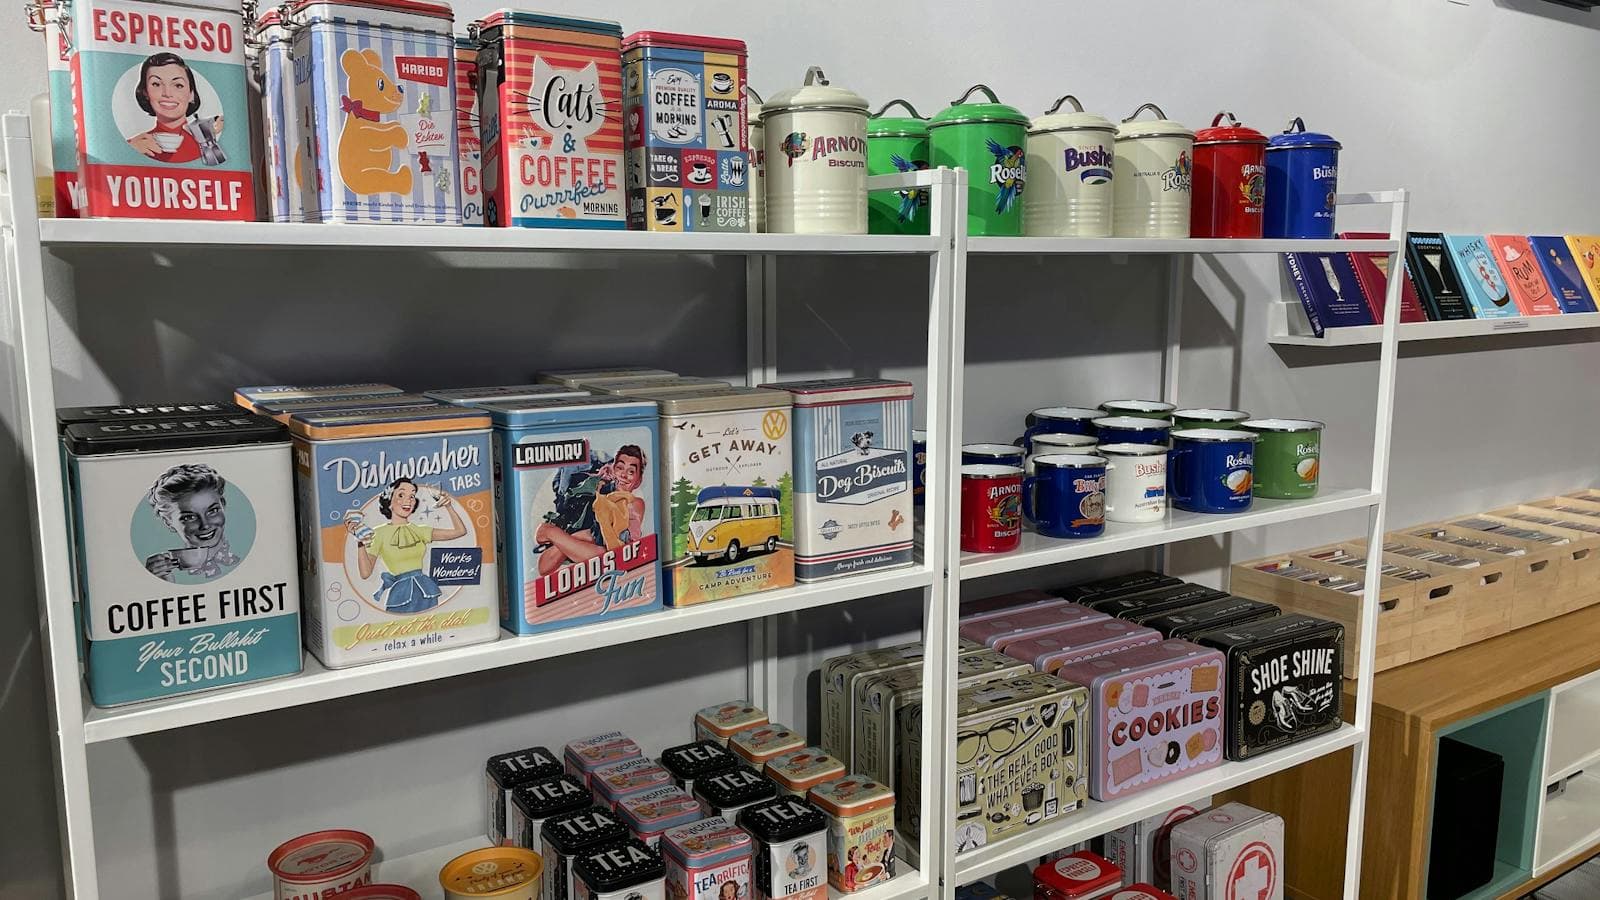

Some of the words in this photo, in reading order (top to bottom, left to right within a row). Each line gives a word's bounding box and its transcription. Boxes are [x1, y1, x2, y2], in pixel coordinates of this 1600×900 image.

[93, 8, 232, 54] ESPRESSO
[401, 62, 444, 77] HARIBO
[543, 75, 595, 128] Cats
[655, 92, 696, 107] COFFEE
[707, 100, 737, 110] AROMA
[656, 112, 697, 126] MORNING
[563, 133, 576, 153] &
[650, 154, 667, 163] TAKE
[650, 164, 656, 172] A
[657, 164, 678, 172] BREAK
[684, 154, 715, 165] ESPRESSO
[520, 155, 617, 189] COFFEE
[107, 175, 242, 211] YOURSELF
[520, 180, 608, 214] Purrrfect
[716, 196, 746, 209] IRISH
[583, 202, 619, 214] MORNING
[717, 208, 746, 217] COFFEE
[1460, 239, 1485, 258] WHISKY
[1286, 252, 1303, 281] YDNEY
[1513, 260, 1535, 280] RUM
[83, 404, 223, 416] COFFEE
[100, 418, 253, 432] COFFEE
[516, 443, 583, 465] LAUNDRY
[689, 442, 721, 464] GET
[729, 439, 777, 455] AWAY
[323, 438, 480, 494] Dishwasher
[449, 472, 481, 492] TABS
[818, 475, 852, 498] Dog
[854, 458, 906, 486] Biscuits
[441, 552, 472, 564] Works
[433, 564, 480, 577] Wonders!
[544, 550, 616, 600] LOADS
[623, 540, 641, 562] OF
[699, 581, 721, 590] CAMP
[725, 573, 772, 586] ADVENTURE
[595, 570, 645, 615] Fun
[108, 593, 206, 634] COFFEE
[219, 582, 287, 620] FIRST
[345, 622, 394, 650] Just
[441, 608, 472, 629] dial
[136, 640, 184, 673] Your
[189, 627, 270, 655] Bullshit
[384, 639, 407, 651] relax
[420, 632, 442, 645] while
[160, 651, 249, 688] SECOND
[1251, 655, 1289, 694] SHOE
[1292, 648, 1335, 678] SHINE
[1112, 696, 1219, 747] COOKIES
[500, 752, 551, 772] TEA
[675, 744, 725, 763] TEA
[988, 769, 1005, 790] THE
[1008, 750, 1032, 779] REAL
[1034, 733, 1058, 758] GOOD
[526, 779, 581, 801] TEA
[709, 770, 762, 790] TEA
[988, 762, 1038, 809] WHATEVER
[1041, 751, 1058, 772] BOX
[755, 801, 812, 823] TEA
[557, 812, 615, 835] TEA
[589, 845, 651, 871] TEA
[784, 883, 797, 895] TEA
[800, 875, 818, 890] FIRST
